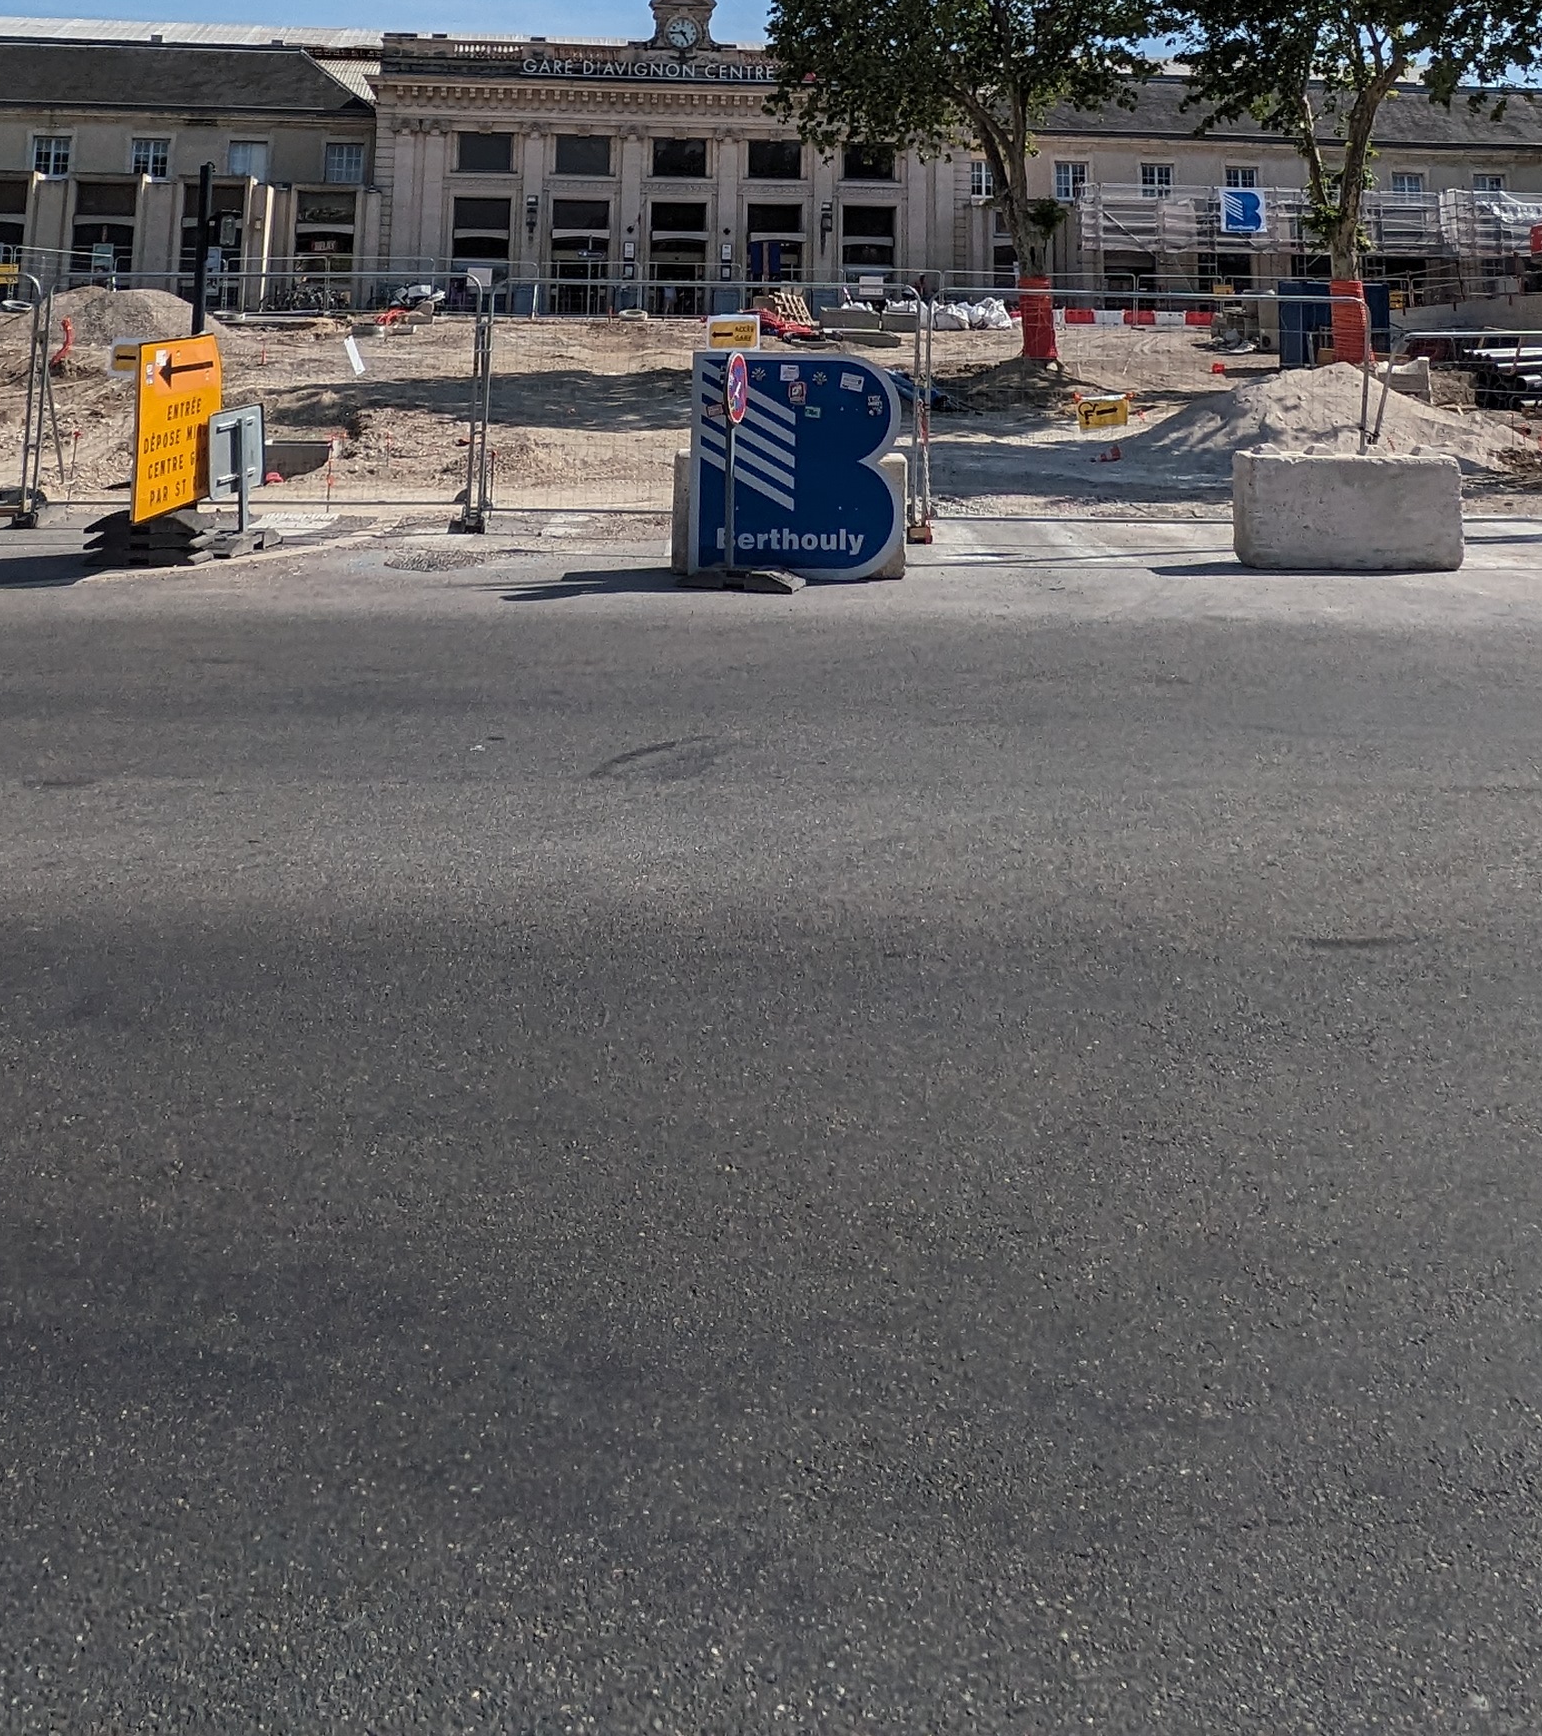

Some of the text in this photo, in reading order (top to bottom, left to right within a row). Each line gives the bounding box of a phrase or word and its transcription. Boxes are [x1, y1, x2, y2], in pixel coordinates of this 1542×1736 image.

[523, 58, 774, 81] GARE D'AVIGNON CENTRE
[167, 398, 202, 421] ENTRÉE
[143, 429, 181, 455] DÉPOSE
[148, 453, 185, 480] CENTRE
[149, 488, 168, 507] PAR
[717, 527, 865, 555] Berthouly
